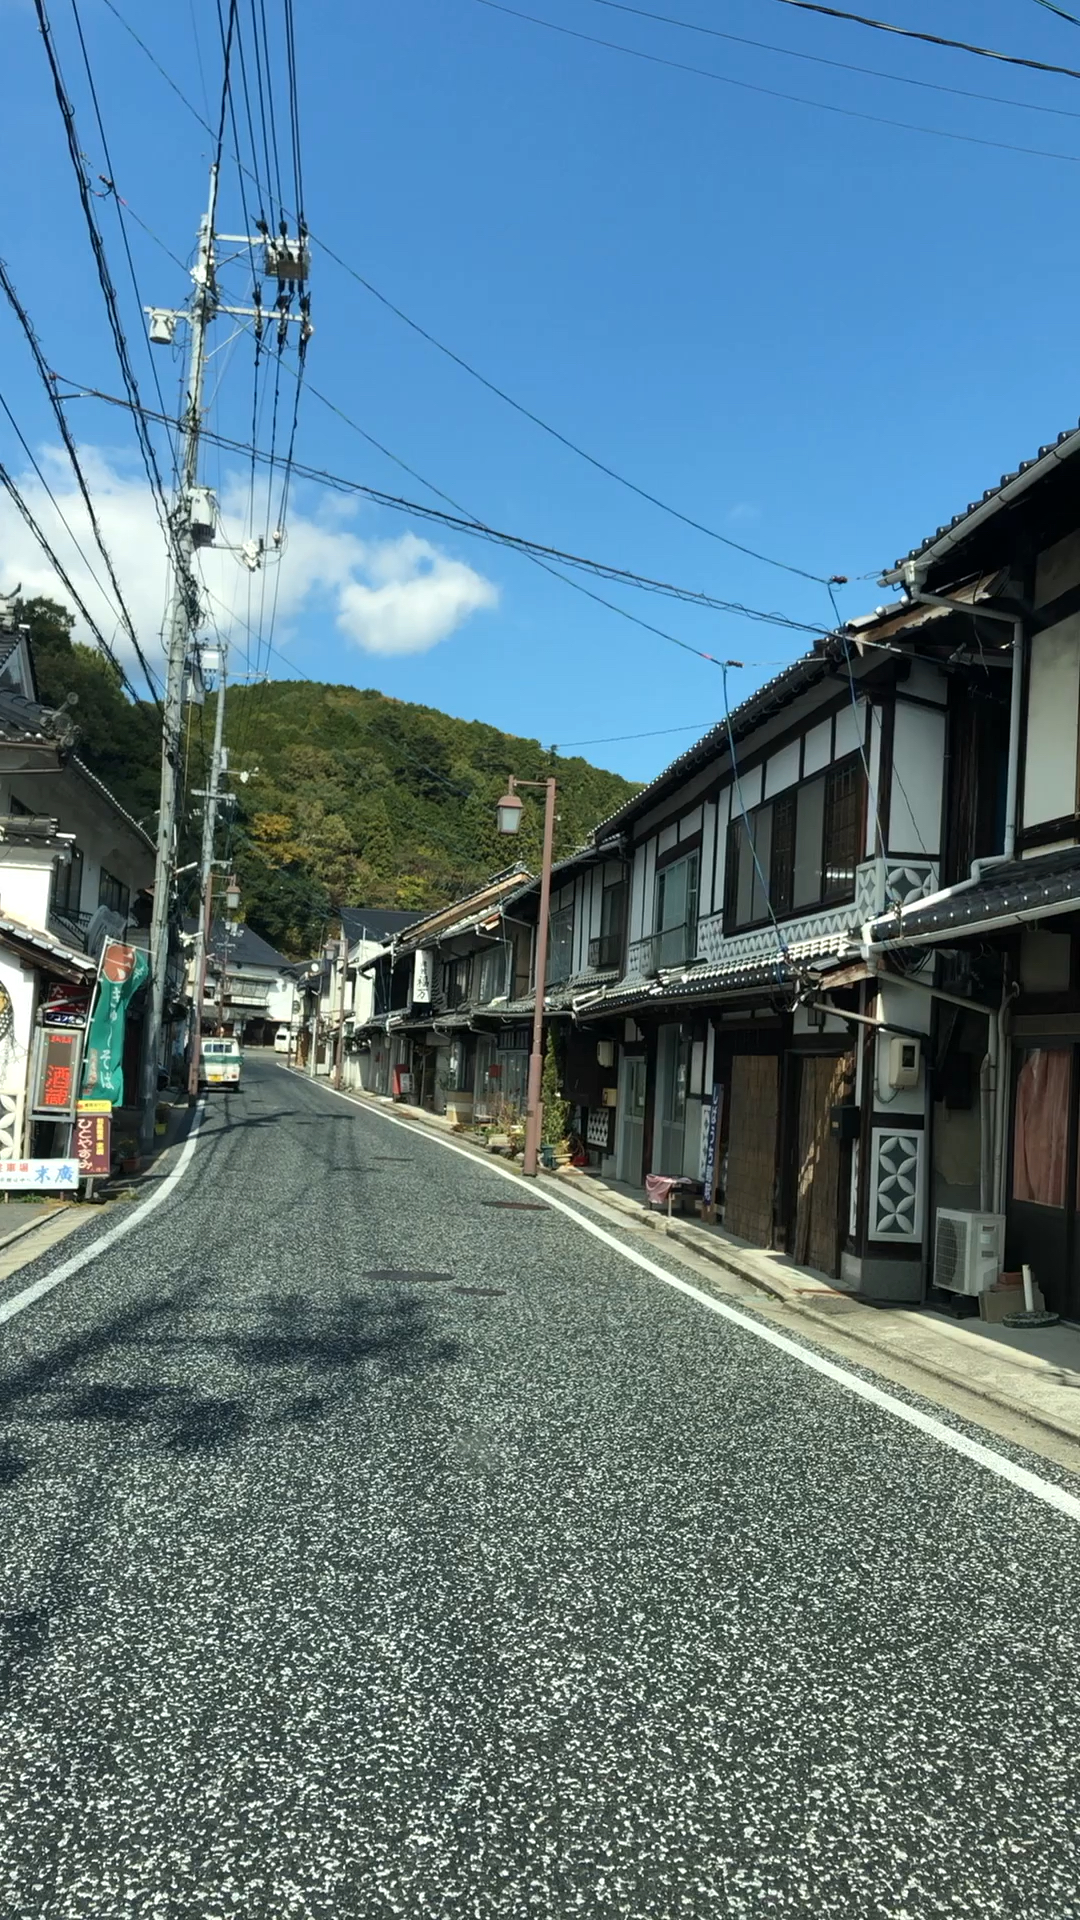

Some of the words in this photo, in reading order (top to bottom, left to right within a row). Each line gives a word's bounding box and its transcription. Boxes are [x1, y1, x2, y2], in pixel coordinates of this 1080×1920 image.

[78, 1118, 93, 1170] ひとやすみ
